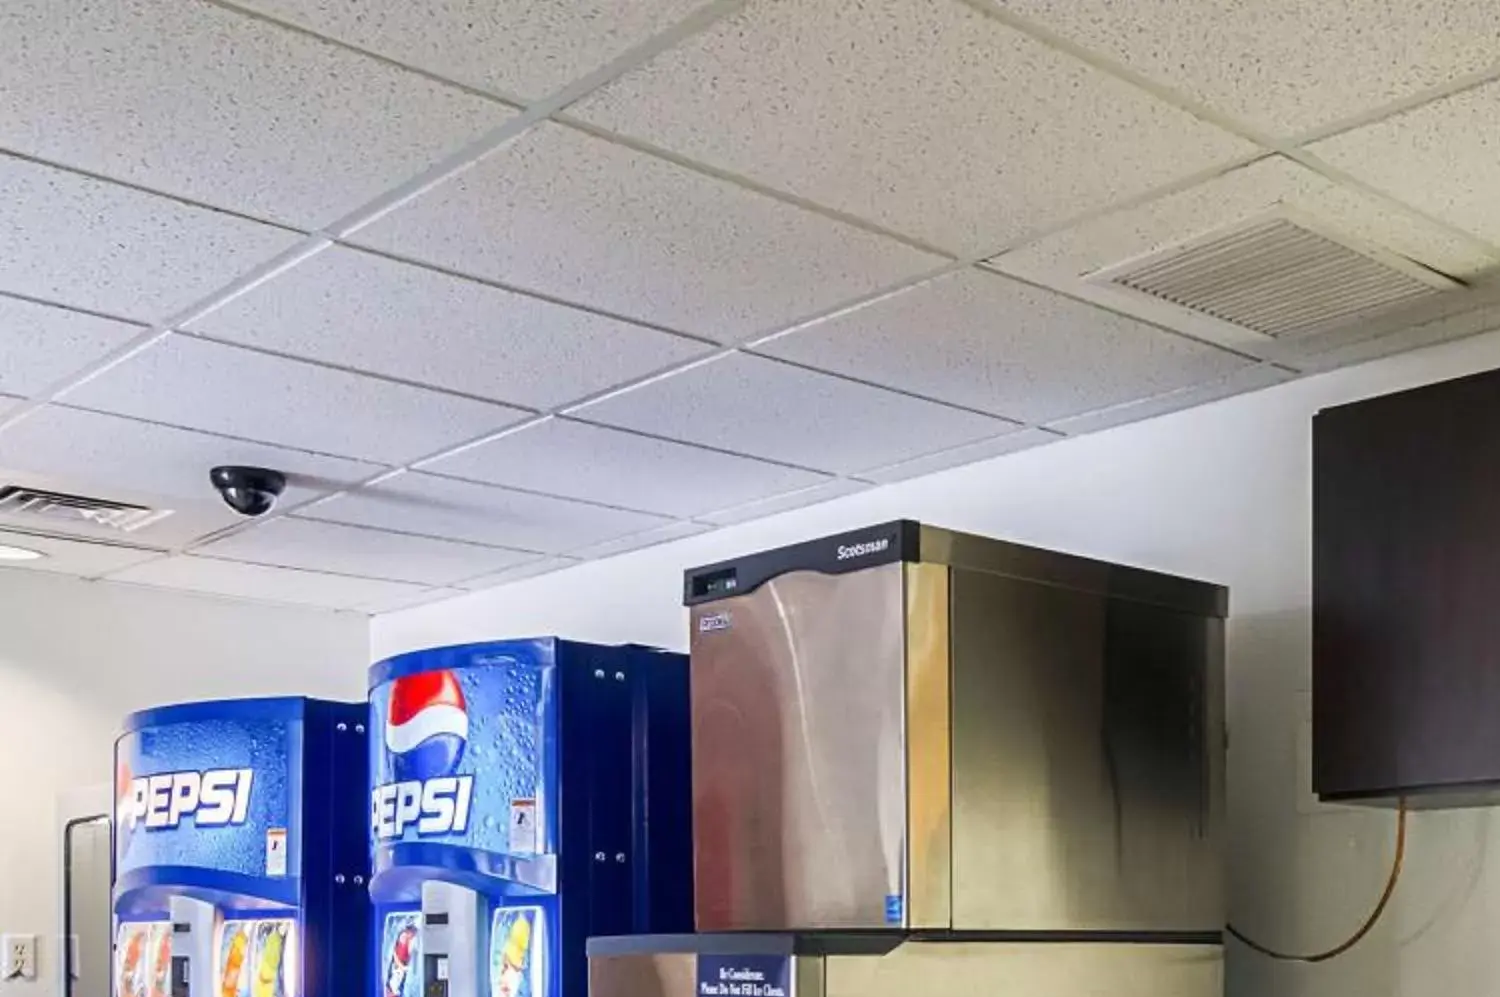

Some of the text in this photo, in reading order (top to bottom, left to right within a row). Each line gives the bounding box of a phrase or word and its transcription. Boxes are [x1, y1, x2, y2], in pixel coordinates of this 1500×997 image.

[837, 538, 889, 560] Scotsman
[130, 768, 255, 834] PEPSI
[371, 774, 475, 840] PEPSI
